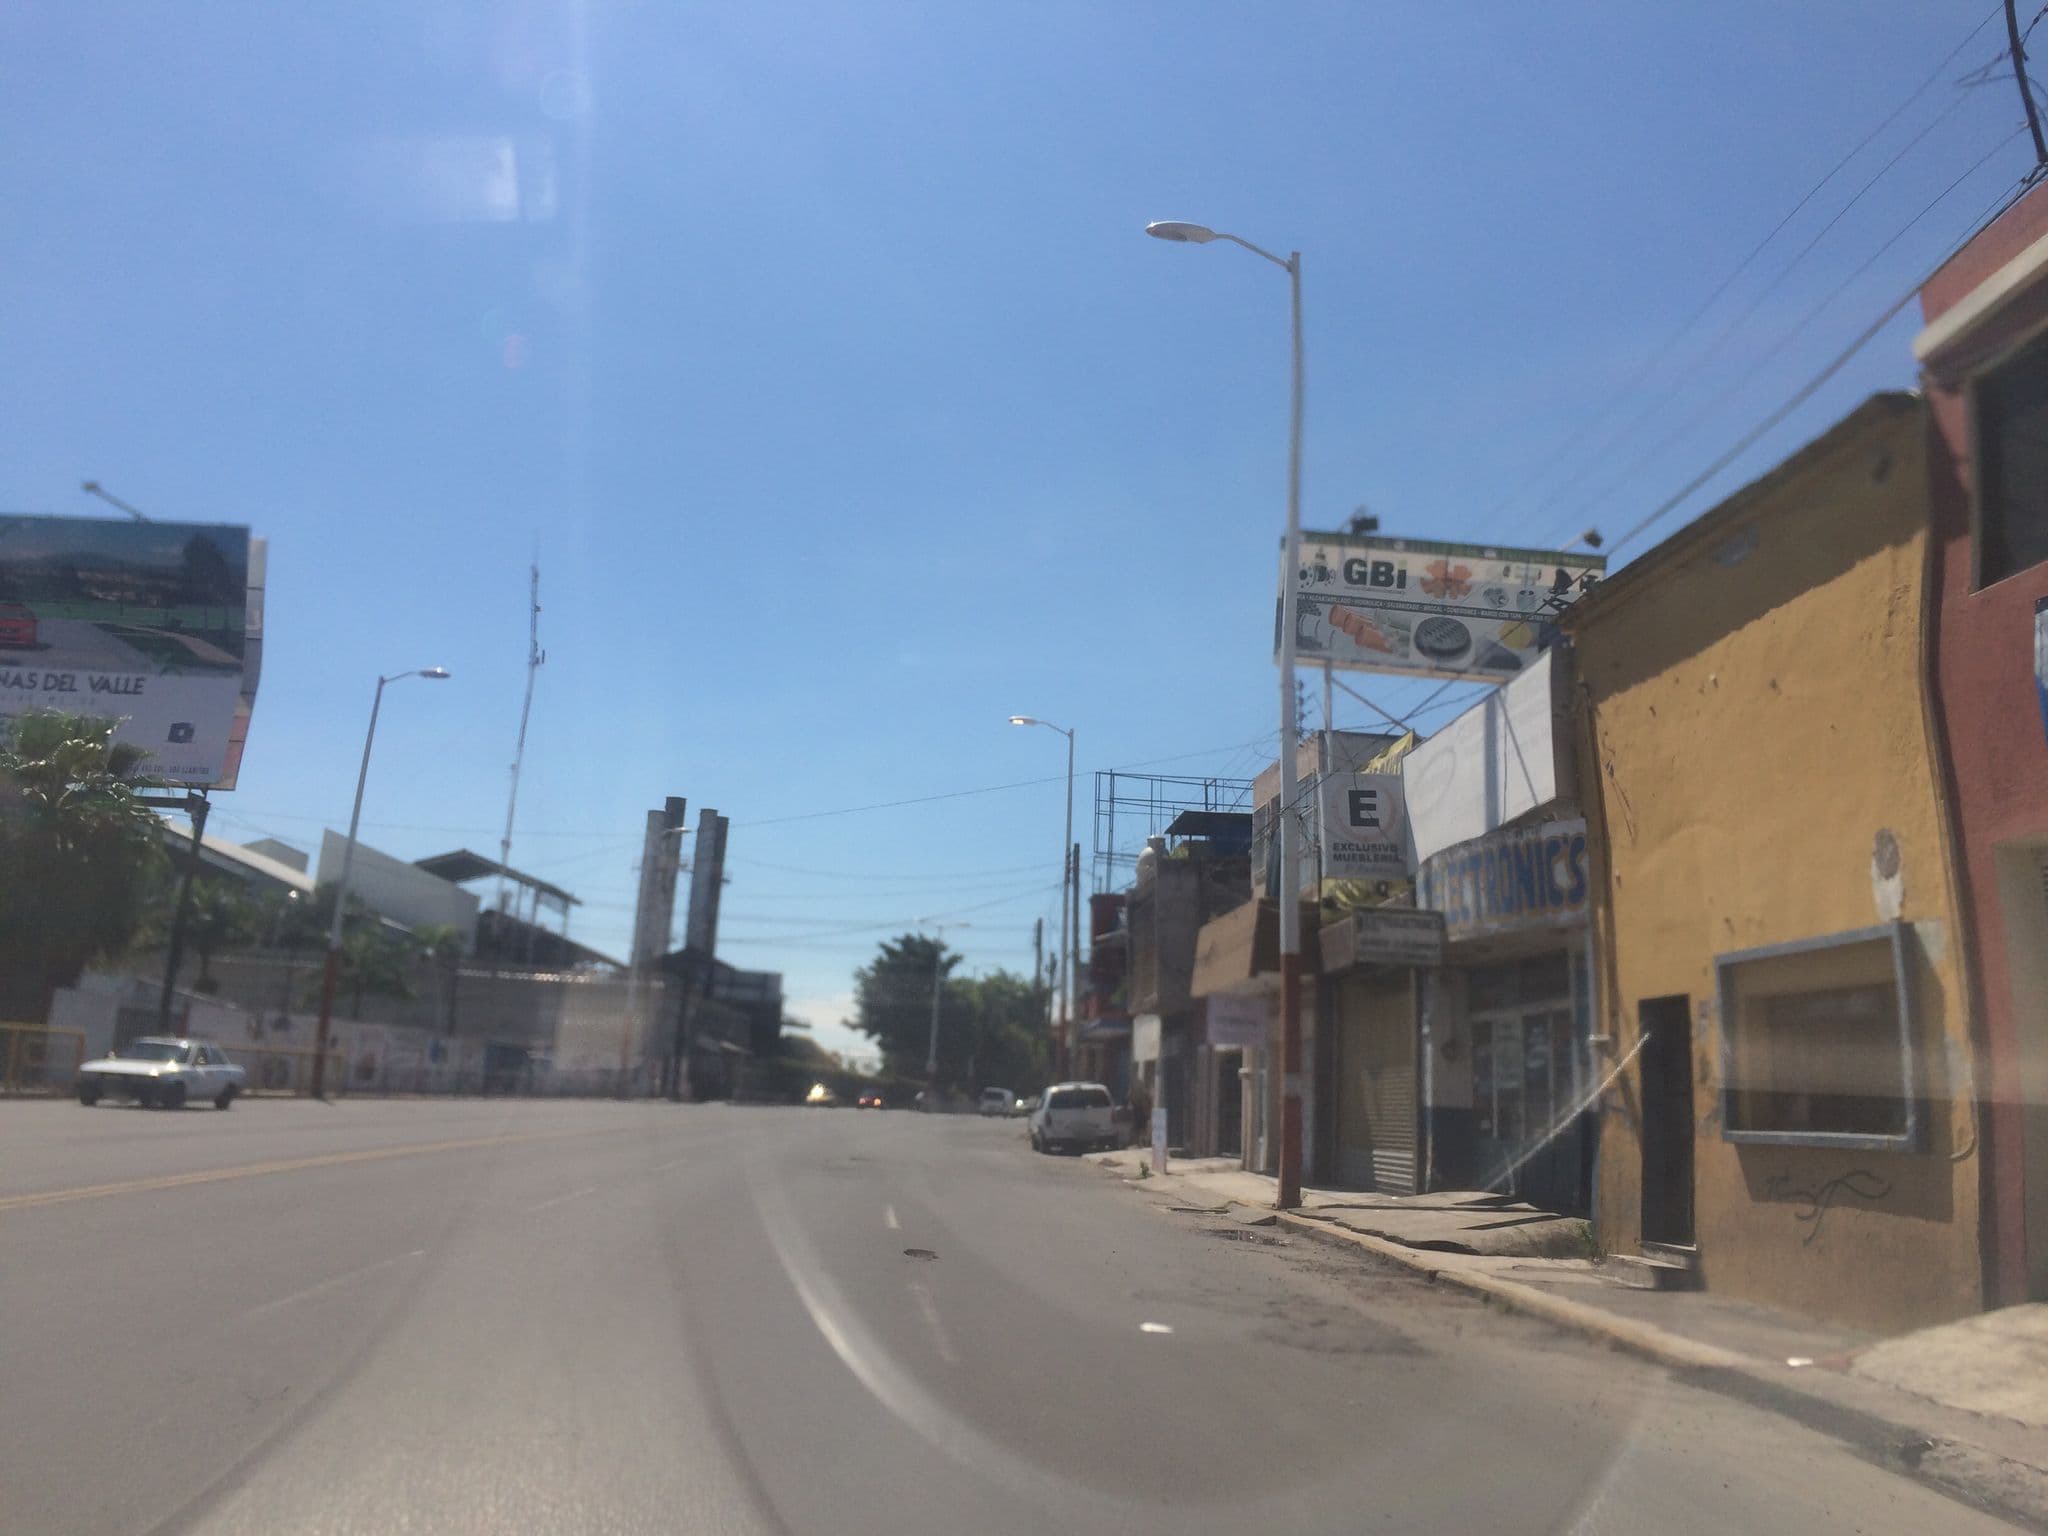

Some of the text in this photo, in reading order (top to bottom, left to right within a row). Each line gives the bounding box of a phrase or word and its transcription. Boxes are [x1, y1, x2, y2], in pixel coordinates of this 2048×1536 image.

[43, 674, 78, 692] DEL
[88, 675, 147, 695] VALLE
[1348, 790, 1380, 828] E
